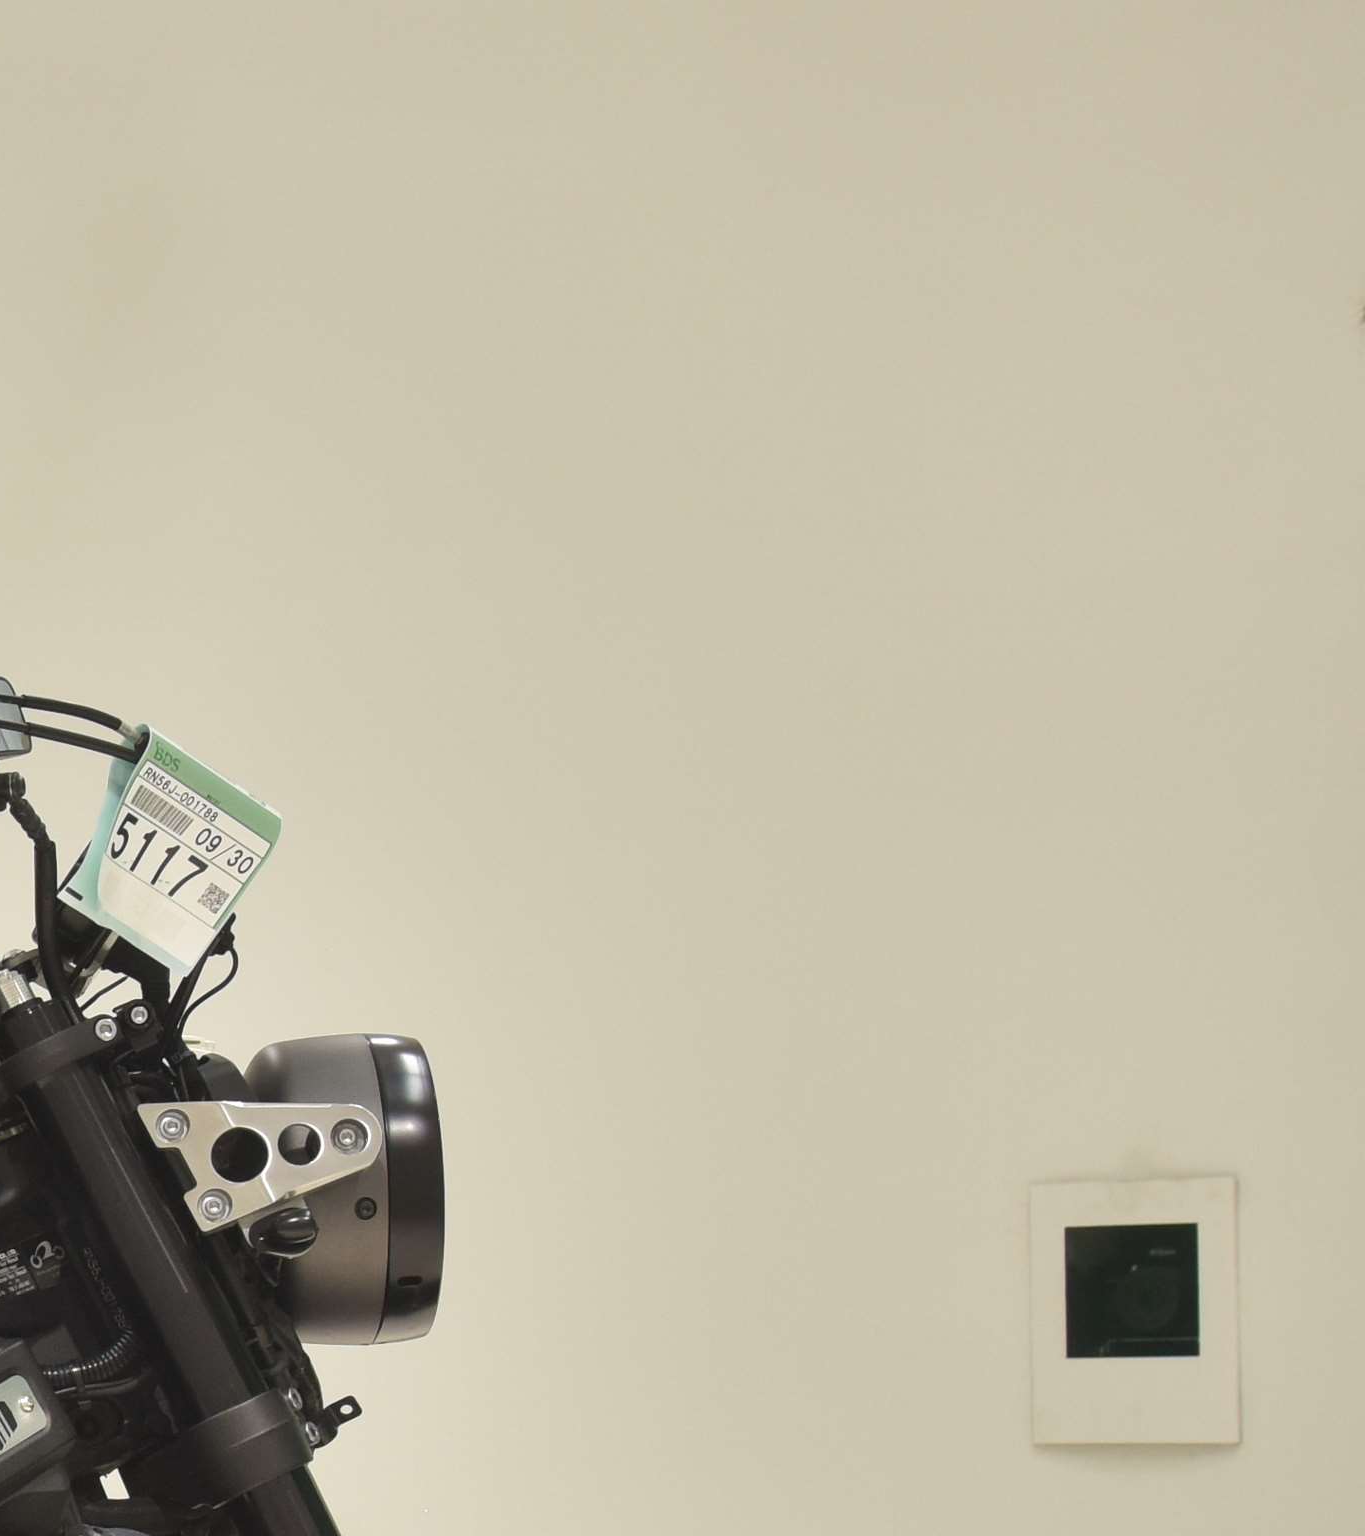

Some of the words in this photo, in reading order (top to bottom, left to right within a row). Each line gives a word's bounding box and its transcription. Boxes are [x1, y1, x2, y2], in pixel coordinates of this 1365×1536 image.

[153, 741, 181, 772] BDS
[142, 766, 219, 823] RN56J-001788
[110, 811, 209, 897] 5117
[194, 827, 255, 875] 09/30
